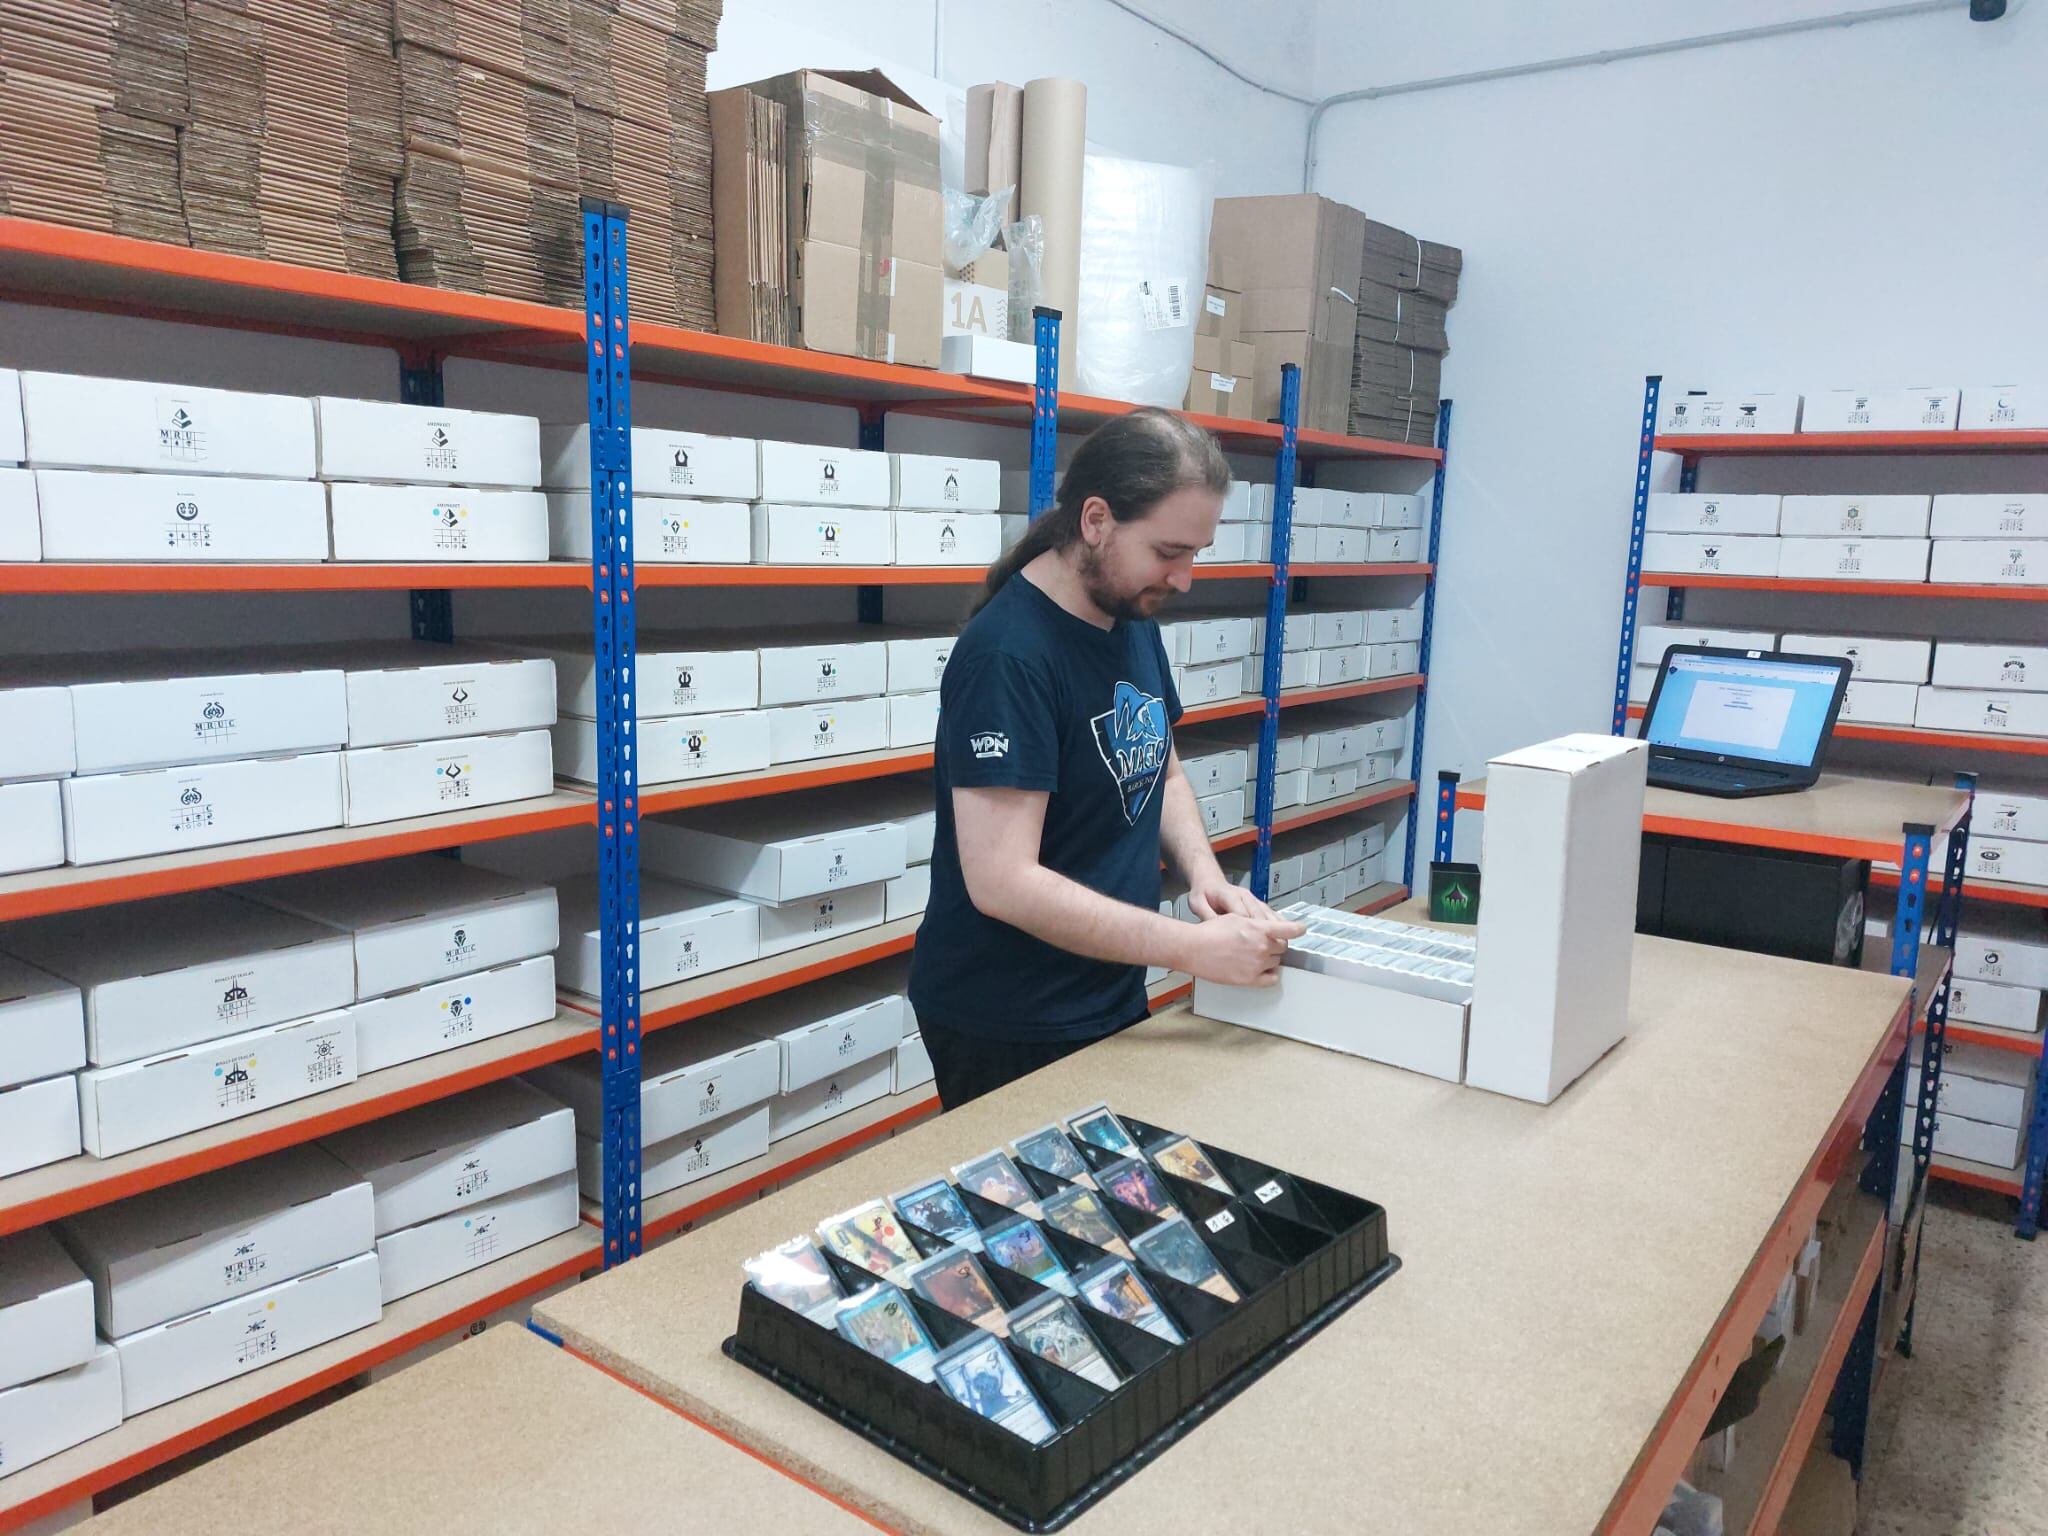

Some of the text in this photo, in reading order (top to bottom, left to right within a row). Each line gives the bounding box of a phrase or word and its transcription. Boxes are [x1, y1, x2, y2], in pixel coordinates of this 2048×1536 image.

[951, 292, 987, 334] 1A
[970, 736, 1009, 753] WPN
[1116, 739, 1164, 782] MAGIC
